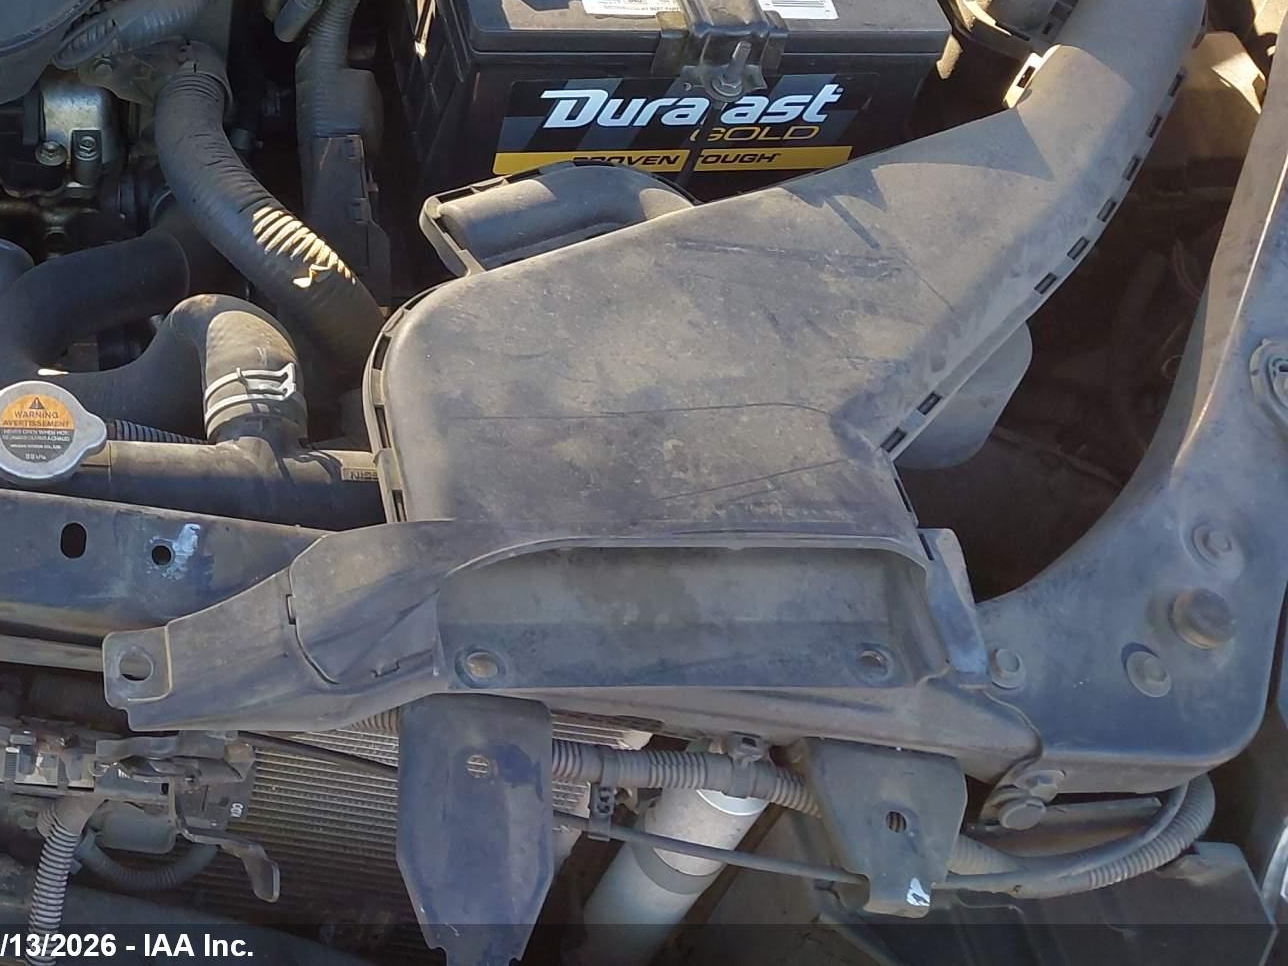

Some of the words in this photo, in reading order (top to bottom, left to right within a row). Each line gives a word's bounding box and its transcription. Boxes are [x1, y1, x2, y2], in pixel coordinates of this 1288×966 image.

[540, 83, 843, 129] Duraast
[699, 153, 777, 165] OUGH
[14, 410, 59, 419] WARNING
